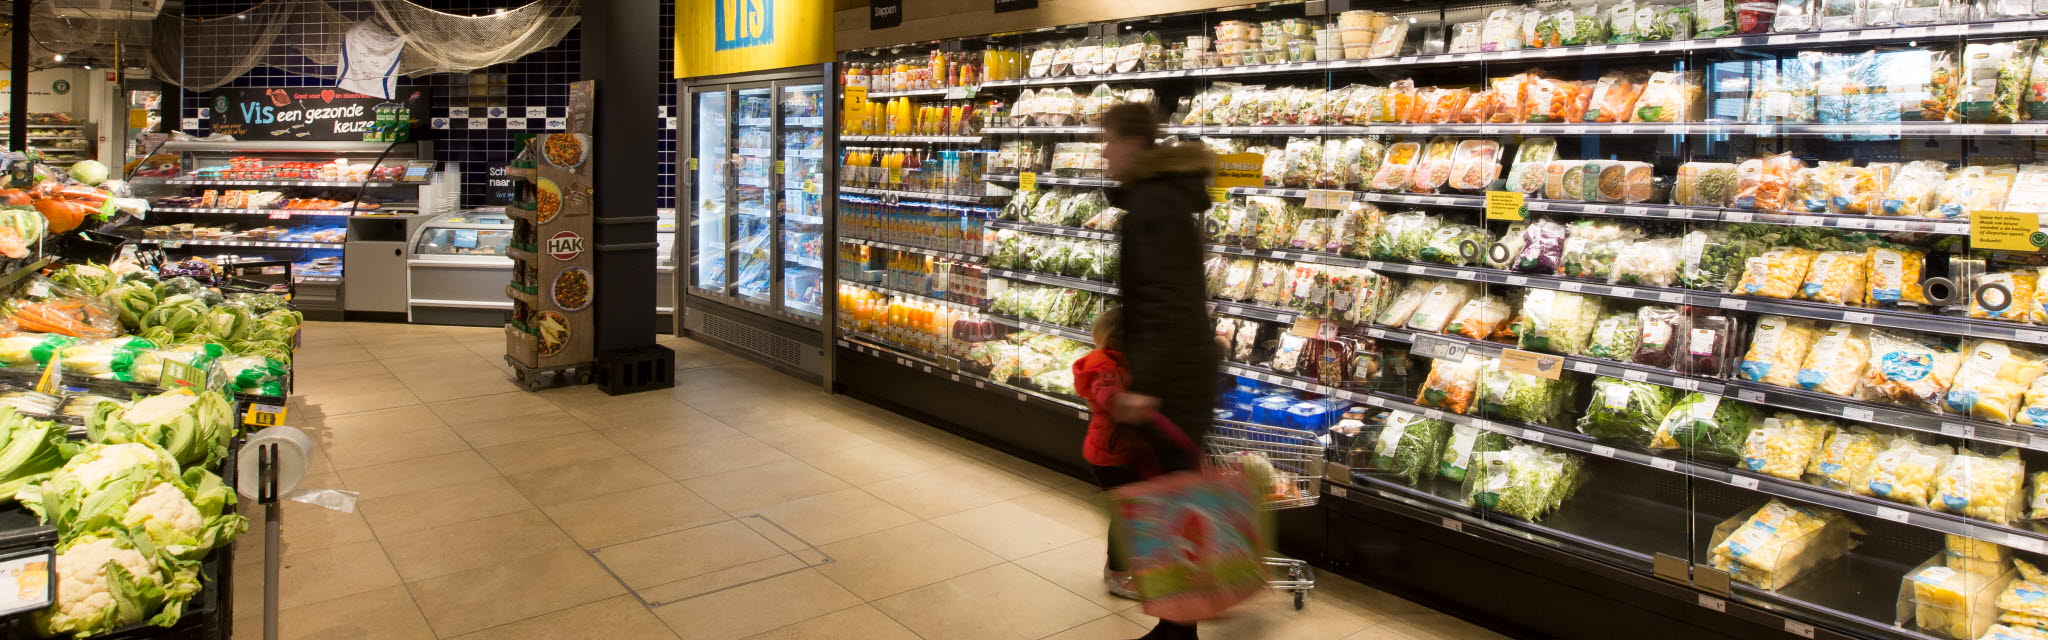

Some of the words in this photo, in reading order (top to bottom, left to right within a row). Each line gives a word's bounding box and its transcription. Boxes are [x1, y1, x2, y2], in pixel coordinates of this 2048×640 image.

[874, 5, 897, 18] Sappen
[240, 102, 274, 124] Vis
[277, 109, 301, 122] een
[304, 103, 364, 124] gezonde
[334, 120, 375, 134] keuze
[489, 167, 506, 176] Sch
[548, 238, 584, 254] HAK
